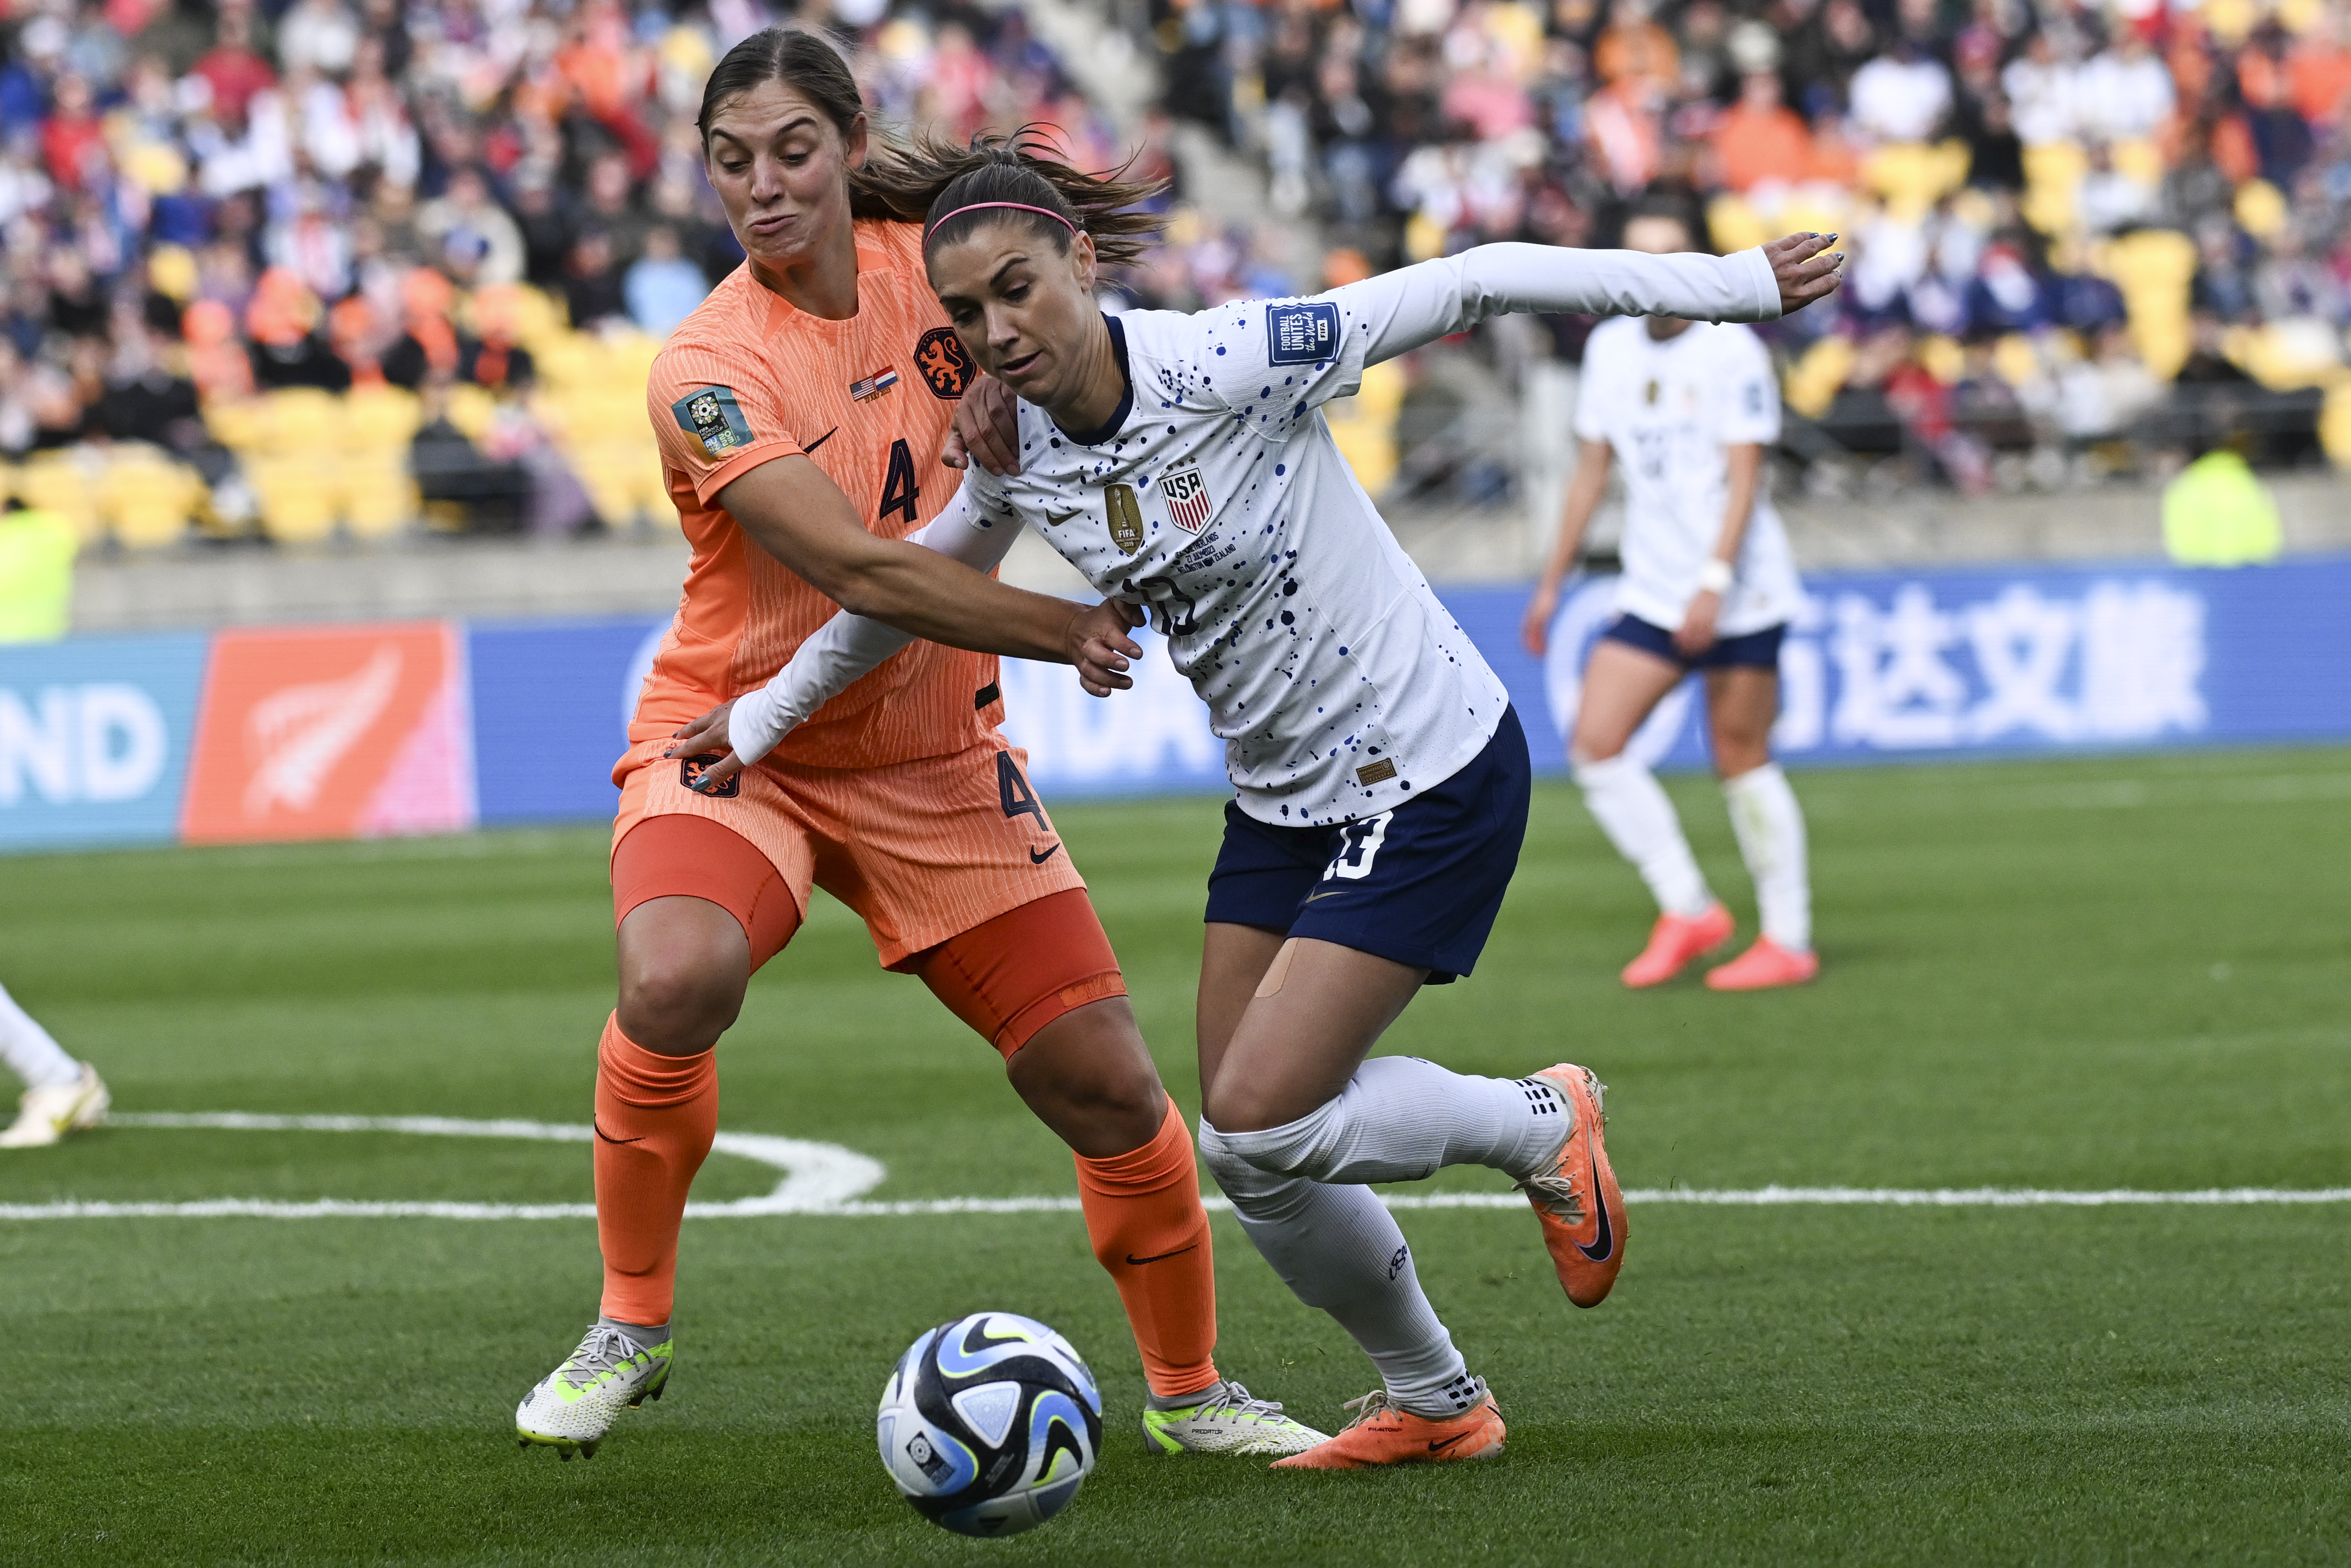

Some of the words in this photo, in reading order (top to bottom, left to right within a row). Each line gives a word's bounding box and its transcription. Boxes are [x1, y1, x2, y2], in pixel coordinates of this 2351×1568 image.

[1279, 315, 1291, 350] FOOTBALL
[1289, 314, 1304, 350] UNITES
[1302, 312, 1315, 336] World
[1305, 337, 1315, 352] the
[702, 431, 716, 440] WORLD
[705, 437, 717, 448] AU
[709, 443, 721, 454] NZ
[879, 438, 919, 523] 4
[1163, 473, 1201, 499] USA
[1118, 529, 1135, 538] FIFA
[1185, 555, 1192, 563] 27
[1192, 550, 1203, 561] JULY
[1203, 545, 1216, 556] 2023
[1212, 544, 1236, 561] ZEALAND
[997, 751, 1049, 831] 4
[1323, 810, 1394, 881] 13
